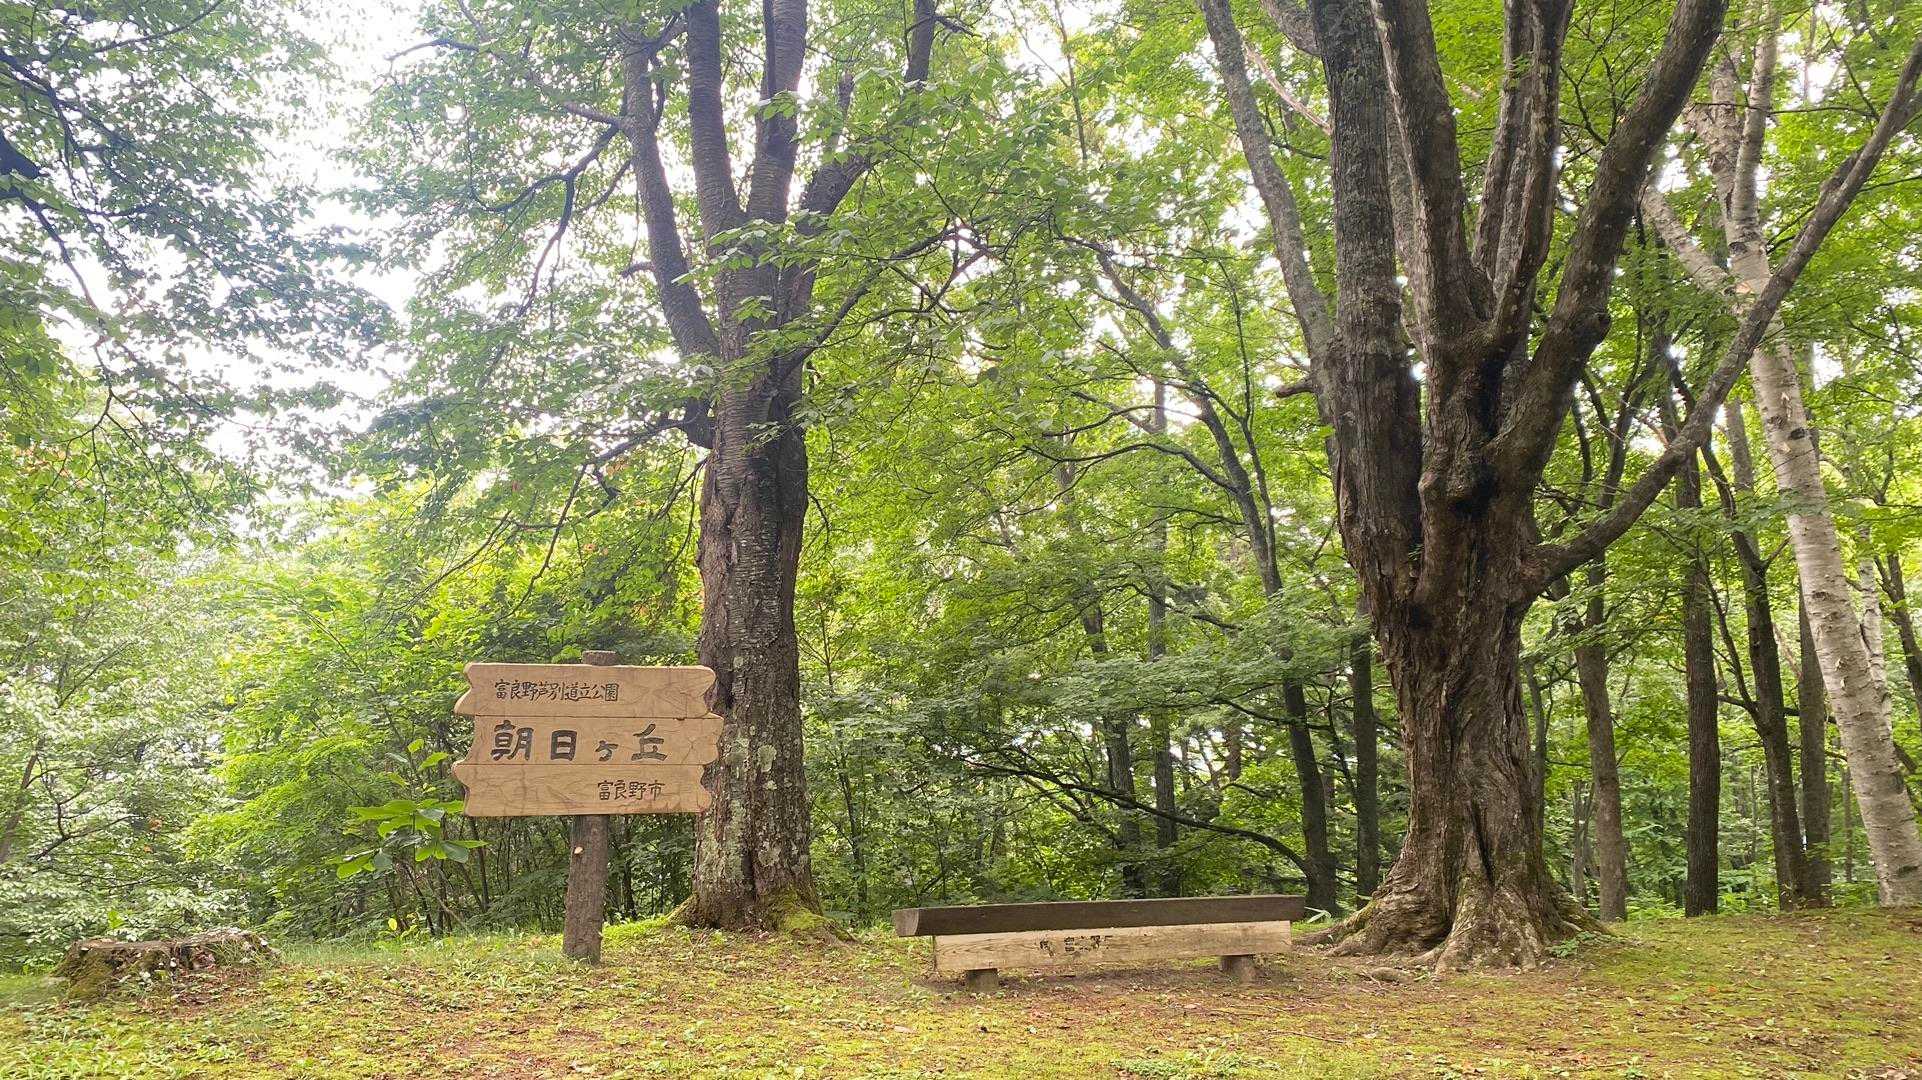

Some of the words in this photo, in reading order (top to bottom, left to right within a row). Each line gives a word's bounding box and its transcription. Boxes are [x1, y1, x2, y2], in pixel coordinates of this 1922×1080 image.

[494, 679, 620, 702] 富良野芦別道立公園
[597, 779, 666, 801] 富良野市
